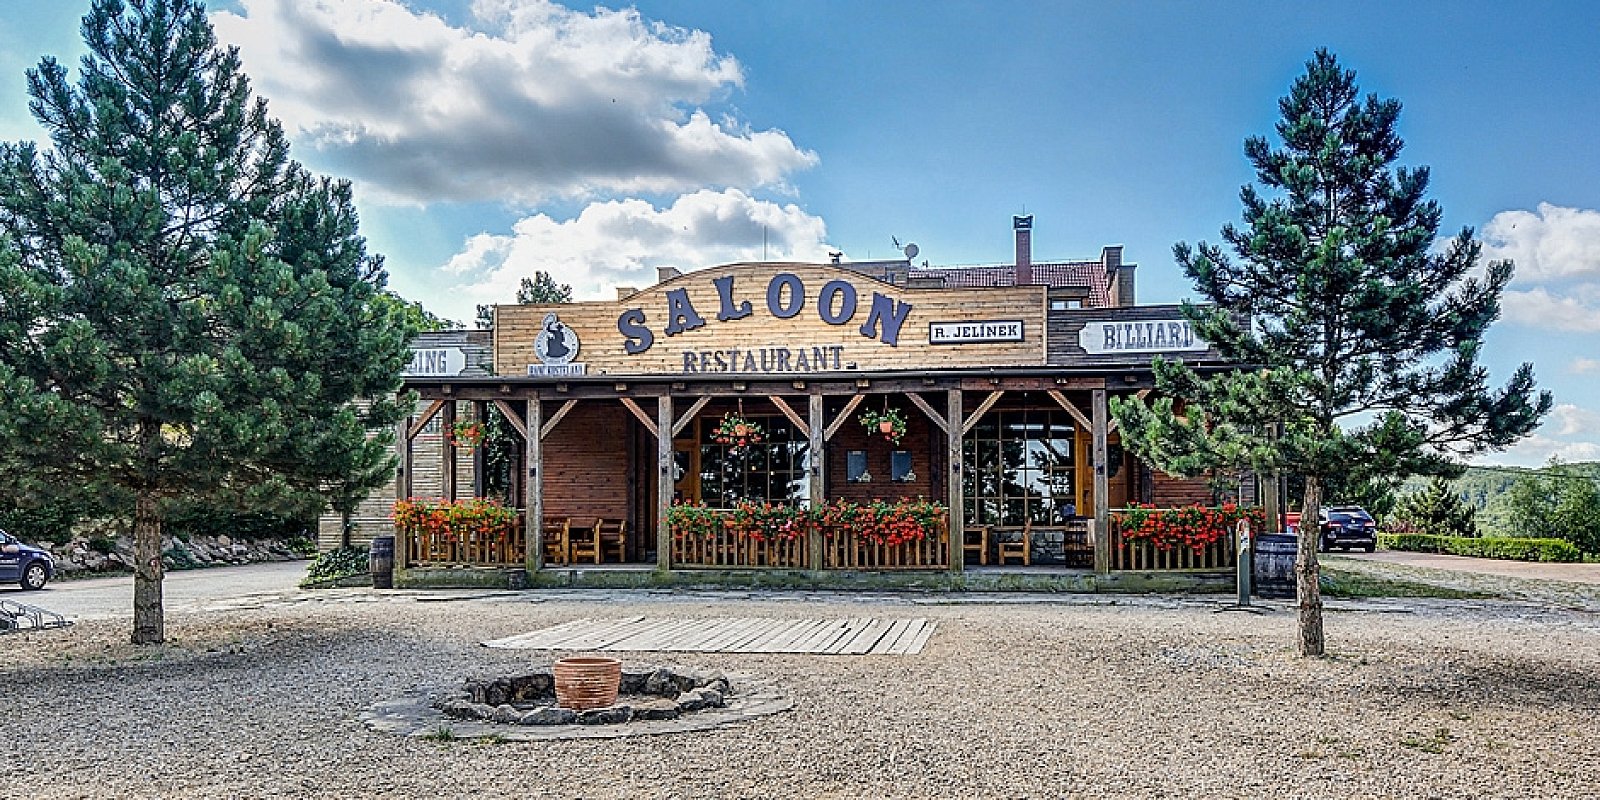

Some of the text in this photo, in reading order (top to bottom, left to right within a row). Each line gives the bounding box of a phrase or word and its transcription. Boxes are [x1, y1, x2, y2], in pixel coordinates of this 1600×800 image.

[617, 272, 912, 355] SALOON
[934, 327, 950, 338] R.
[1102, 322, 1194, 350] BILLIARD
[681, 345, 844, 372] RESTAURANT
